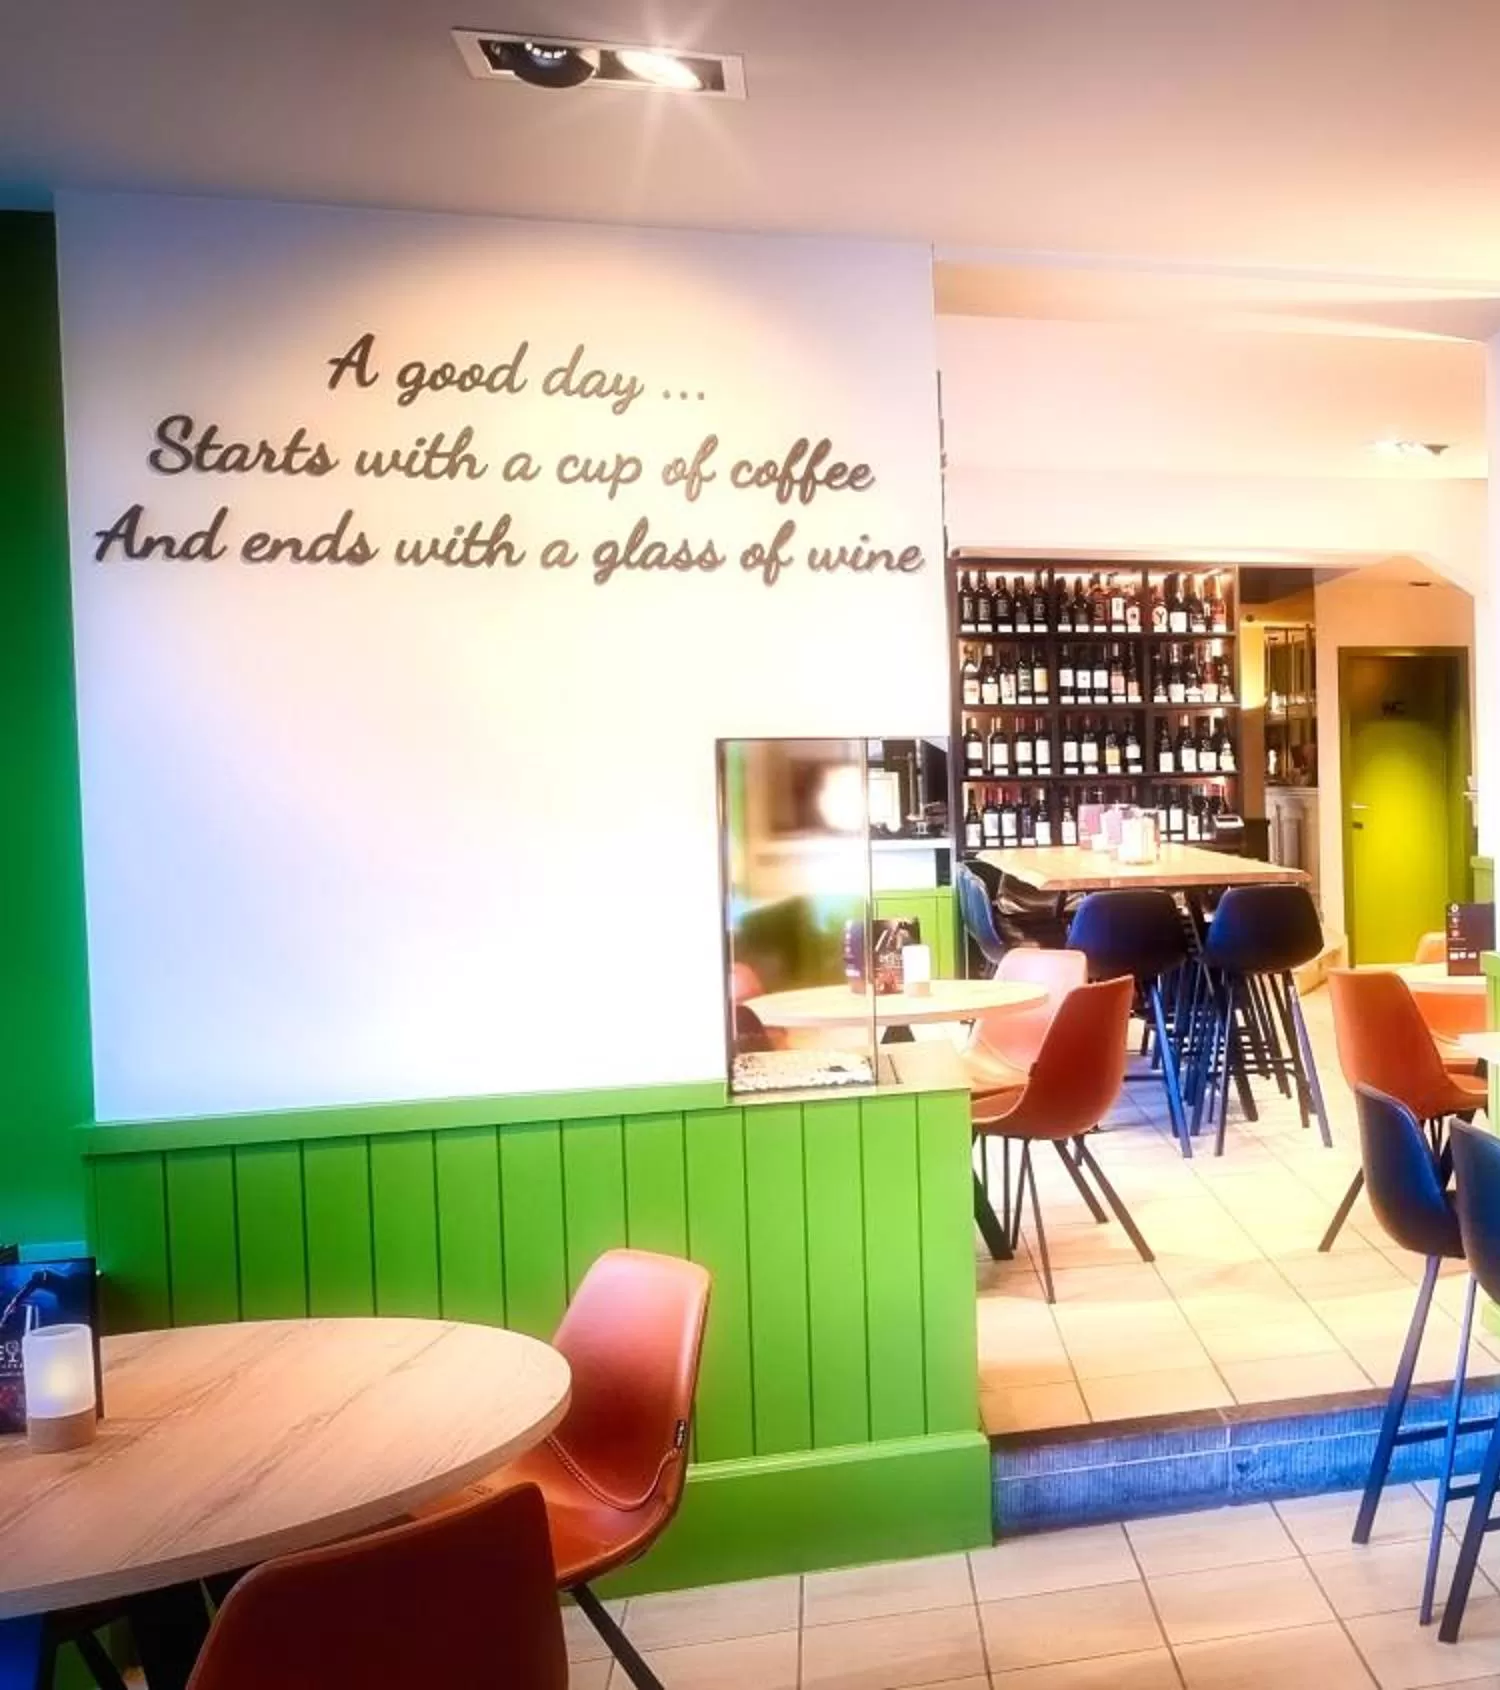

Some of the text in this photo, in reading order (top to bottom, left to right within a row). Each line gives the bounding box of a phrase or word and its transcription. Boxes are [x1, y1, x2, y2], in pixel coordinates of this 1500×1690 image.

[326, 332, 380, 391] A
[396, 341, 529, 407] good
[542, 344, 645, 416] day
[147, 414, 877, 506] Starts with a cup of coffee
[92, 504, 925, 587] And ends with a glass of wine
